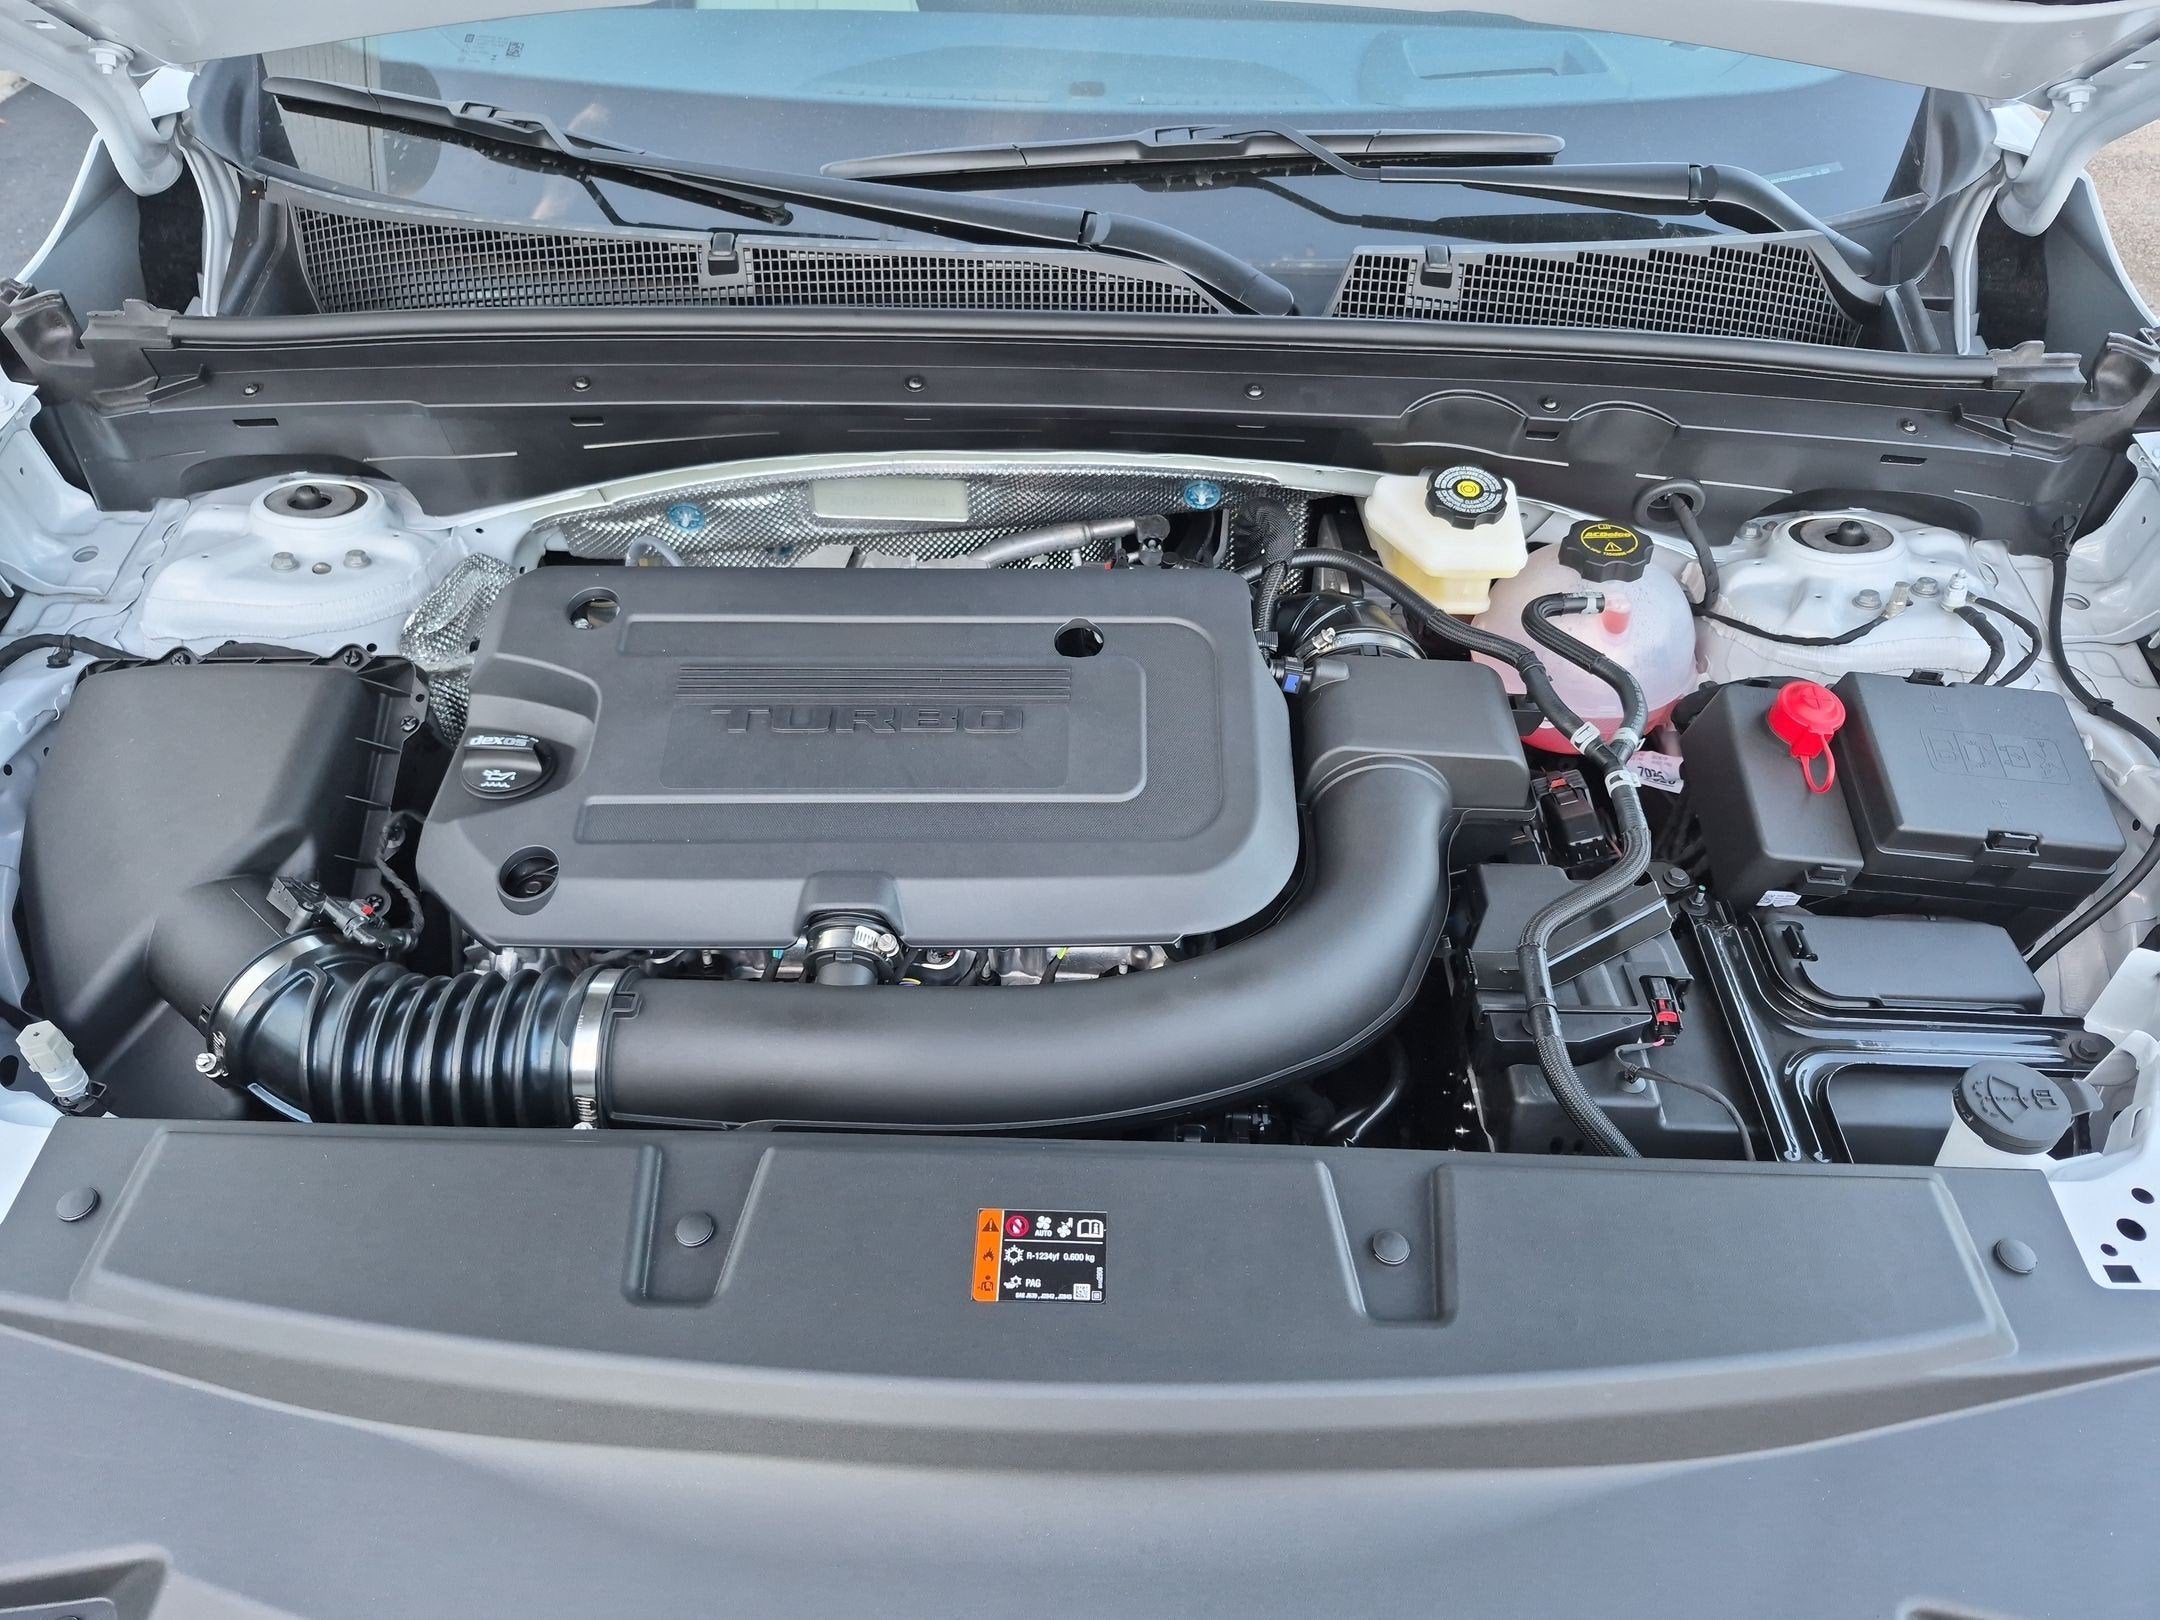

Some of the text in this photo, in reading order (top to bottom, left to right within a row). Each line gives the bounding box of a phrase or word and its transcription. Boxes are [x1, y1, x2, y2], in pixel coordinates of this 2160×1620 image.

[711, 705, 1024, 734] TURBO
[469, 735, 529, 747] dexos
[1034, 1229, 1053, 1237] AUTO
[1026, 1251, 1096, 1263] R-1234yf 0.600 kg
[1025, 1278, 1042, 1288] PAG
